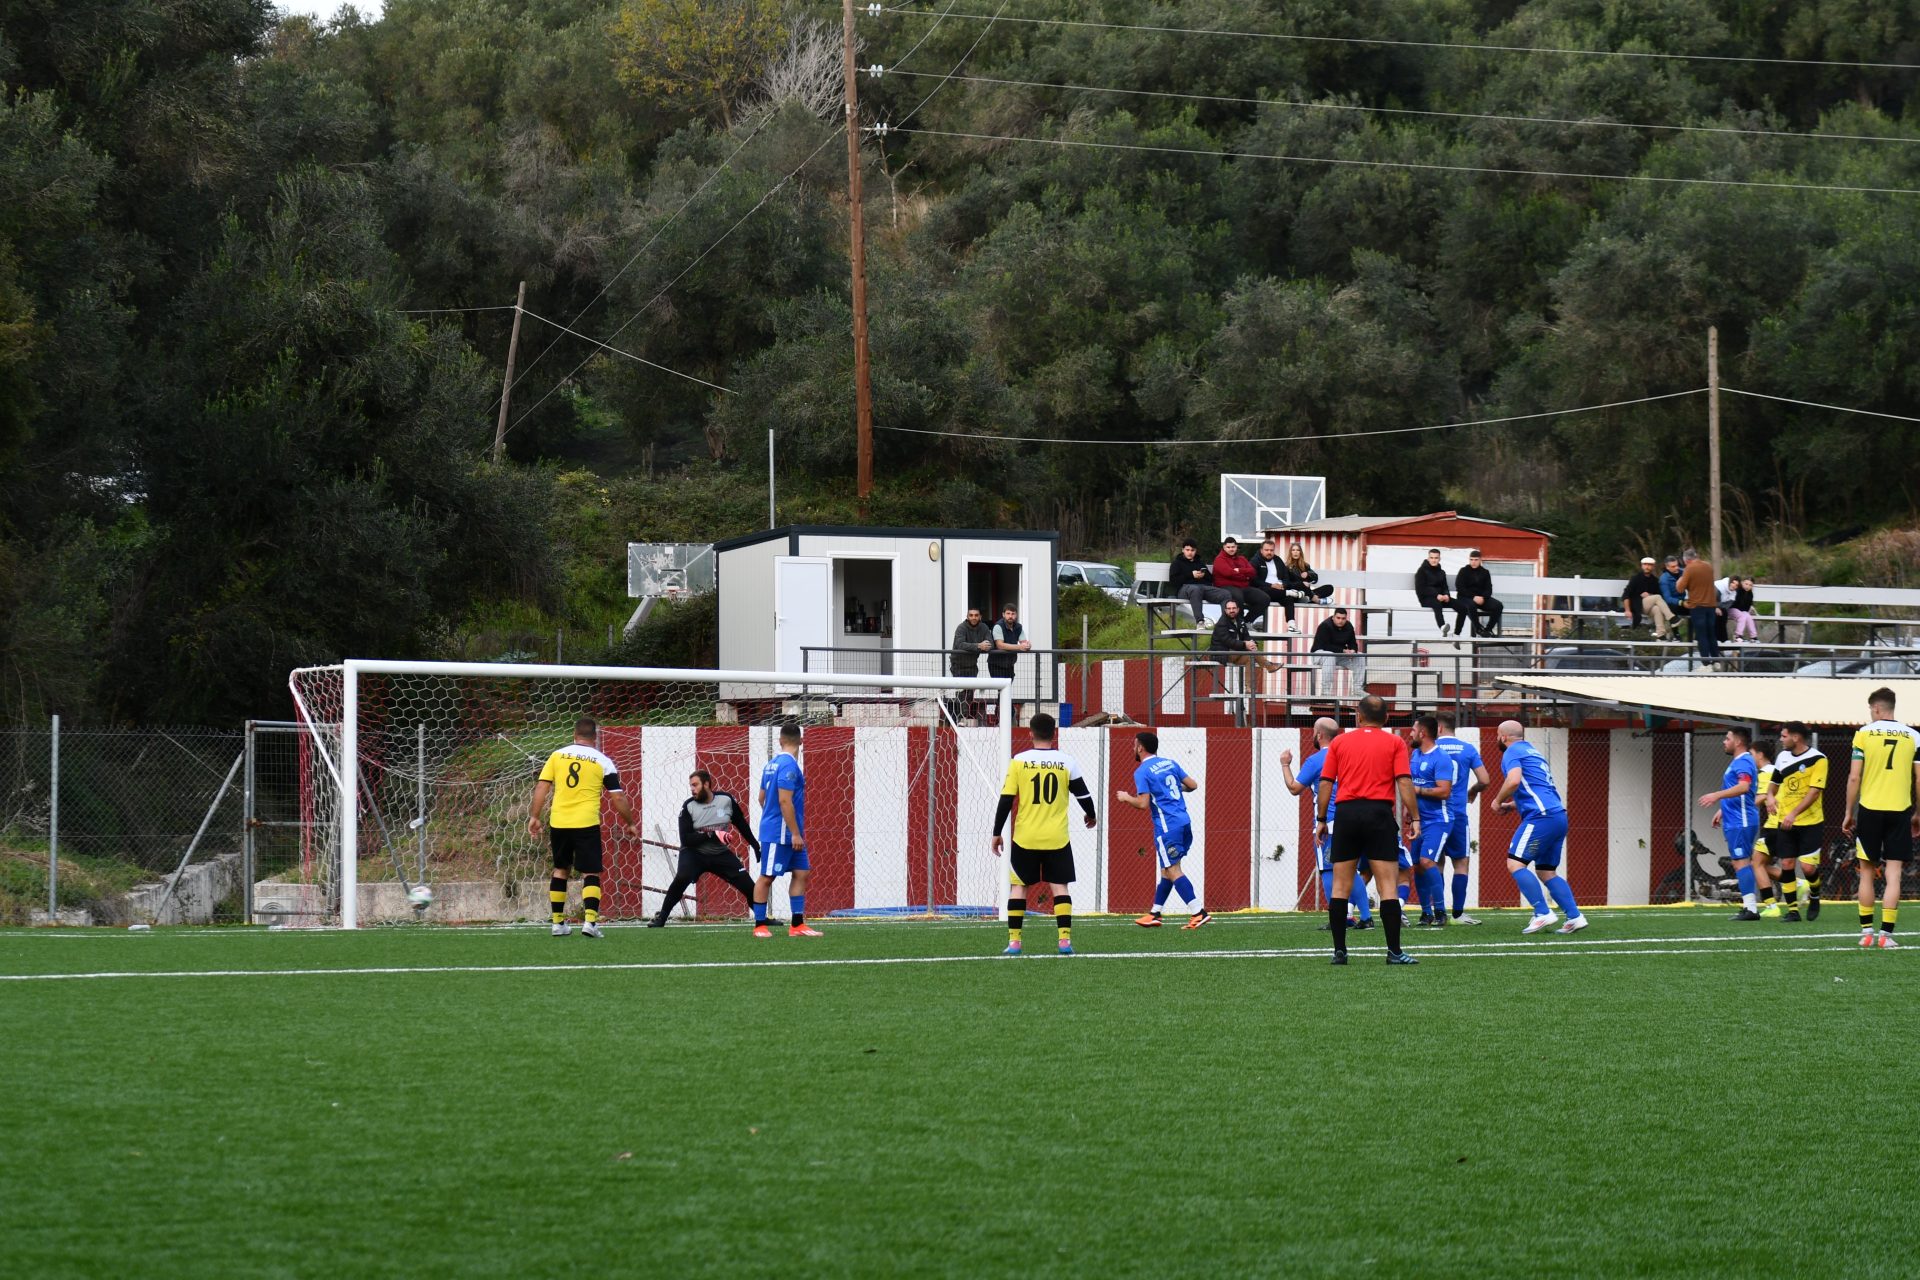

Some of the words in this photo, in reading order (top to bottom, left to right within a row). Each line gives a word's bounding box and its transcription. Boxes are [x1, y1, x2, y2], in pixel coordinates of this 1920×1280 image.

[1886, 729, 1910, 740] ΒΟΛΙΣ
[575, 753, 598, 764] ΒΟΛΙΣ
[1023, 760, 1038, 769] Α.Σ.
[1041, 760, 1065, 770] ΒΟΛΙΣ
[1883, 739, 1898, 770] 7
[566, 761, 581, 788] 8
[1165, 774, 1181, 800] 3
[1030, 771, 1059, 805] 10
